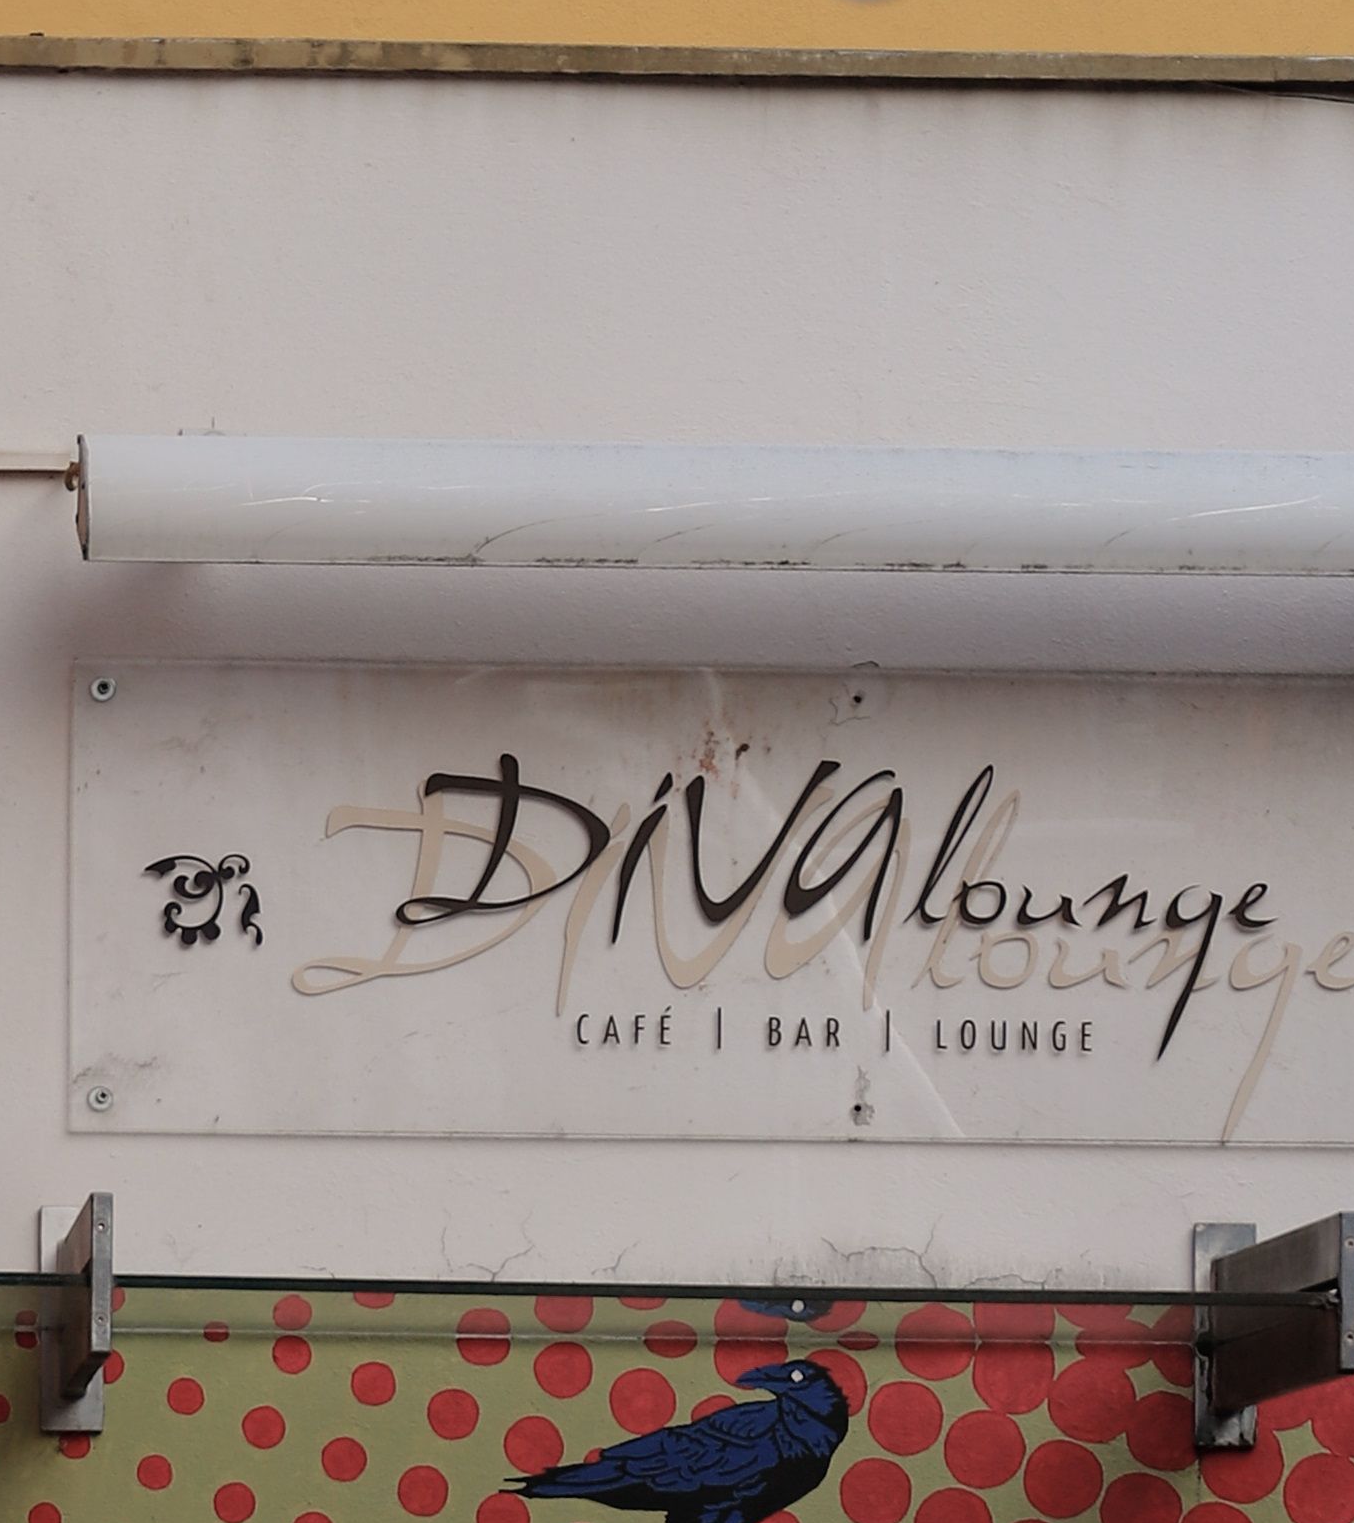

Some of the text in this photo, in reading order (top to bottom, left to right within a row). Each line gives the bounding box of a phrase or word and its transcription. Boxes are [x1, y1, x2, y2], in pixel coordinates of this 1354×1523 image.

[576, 1006, 1093, 1052] CAFÉ BAR LOUNGE
